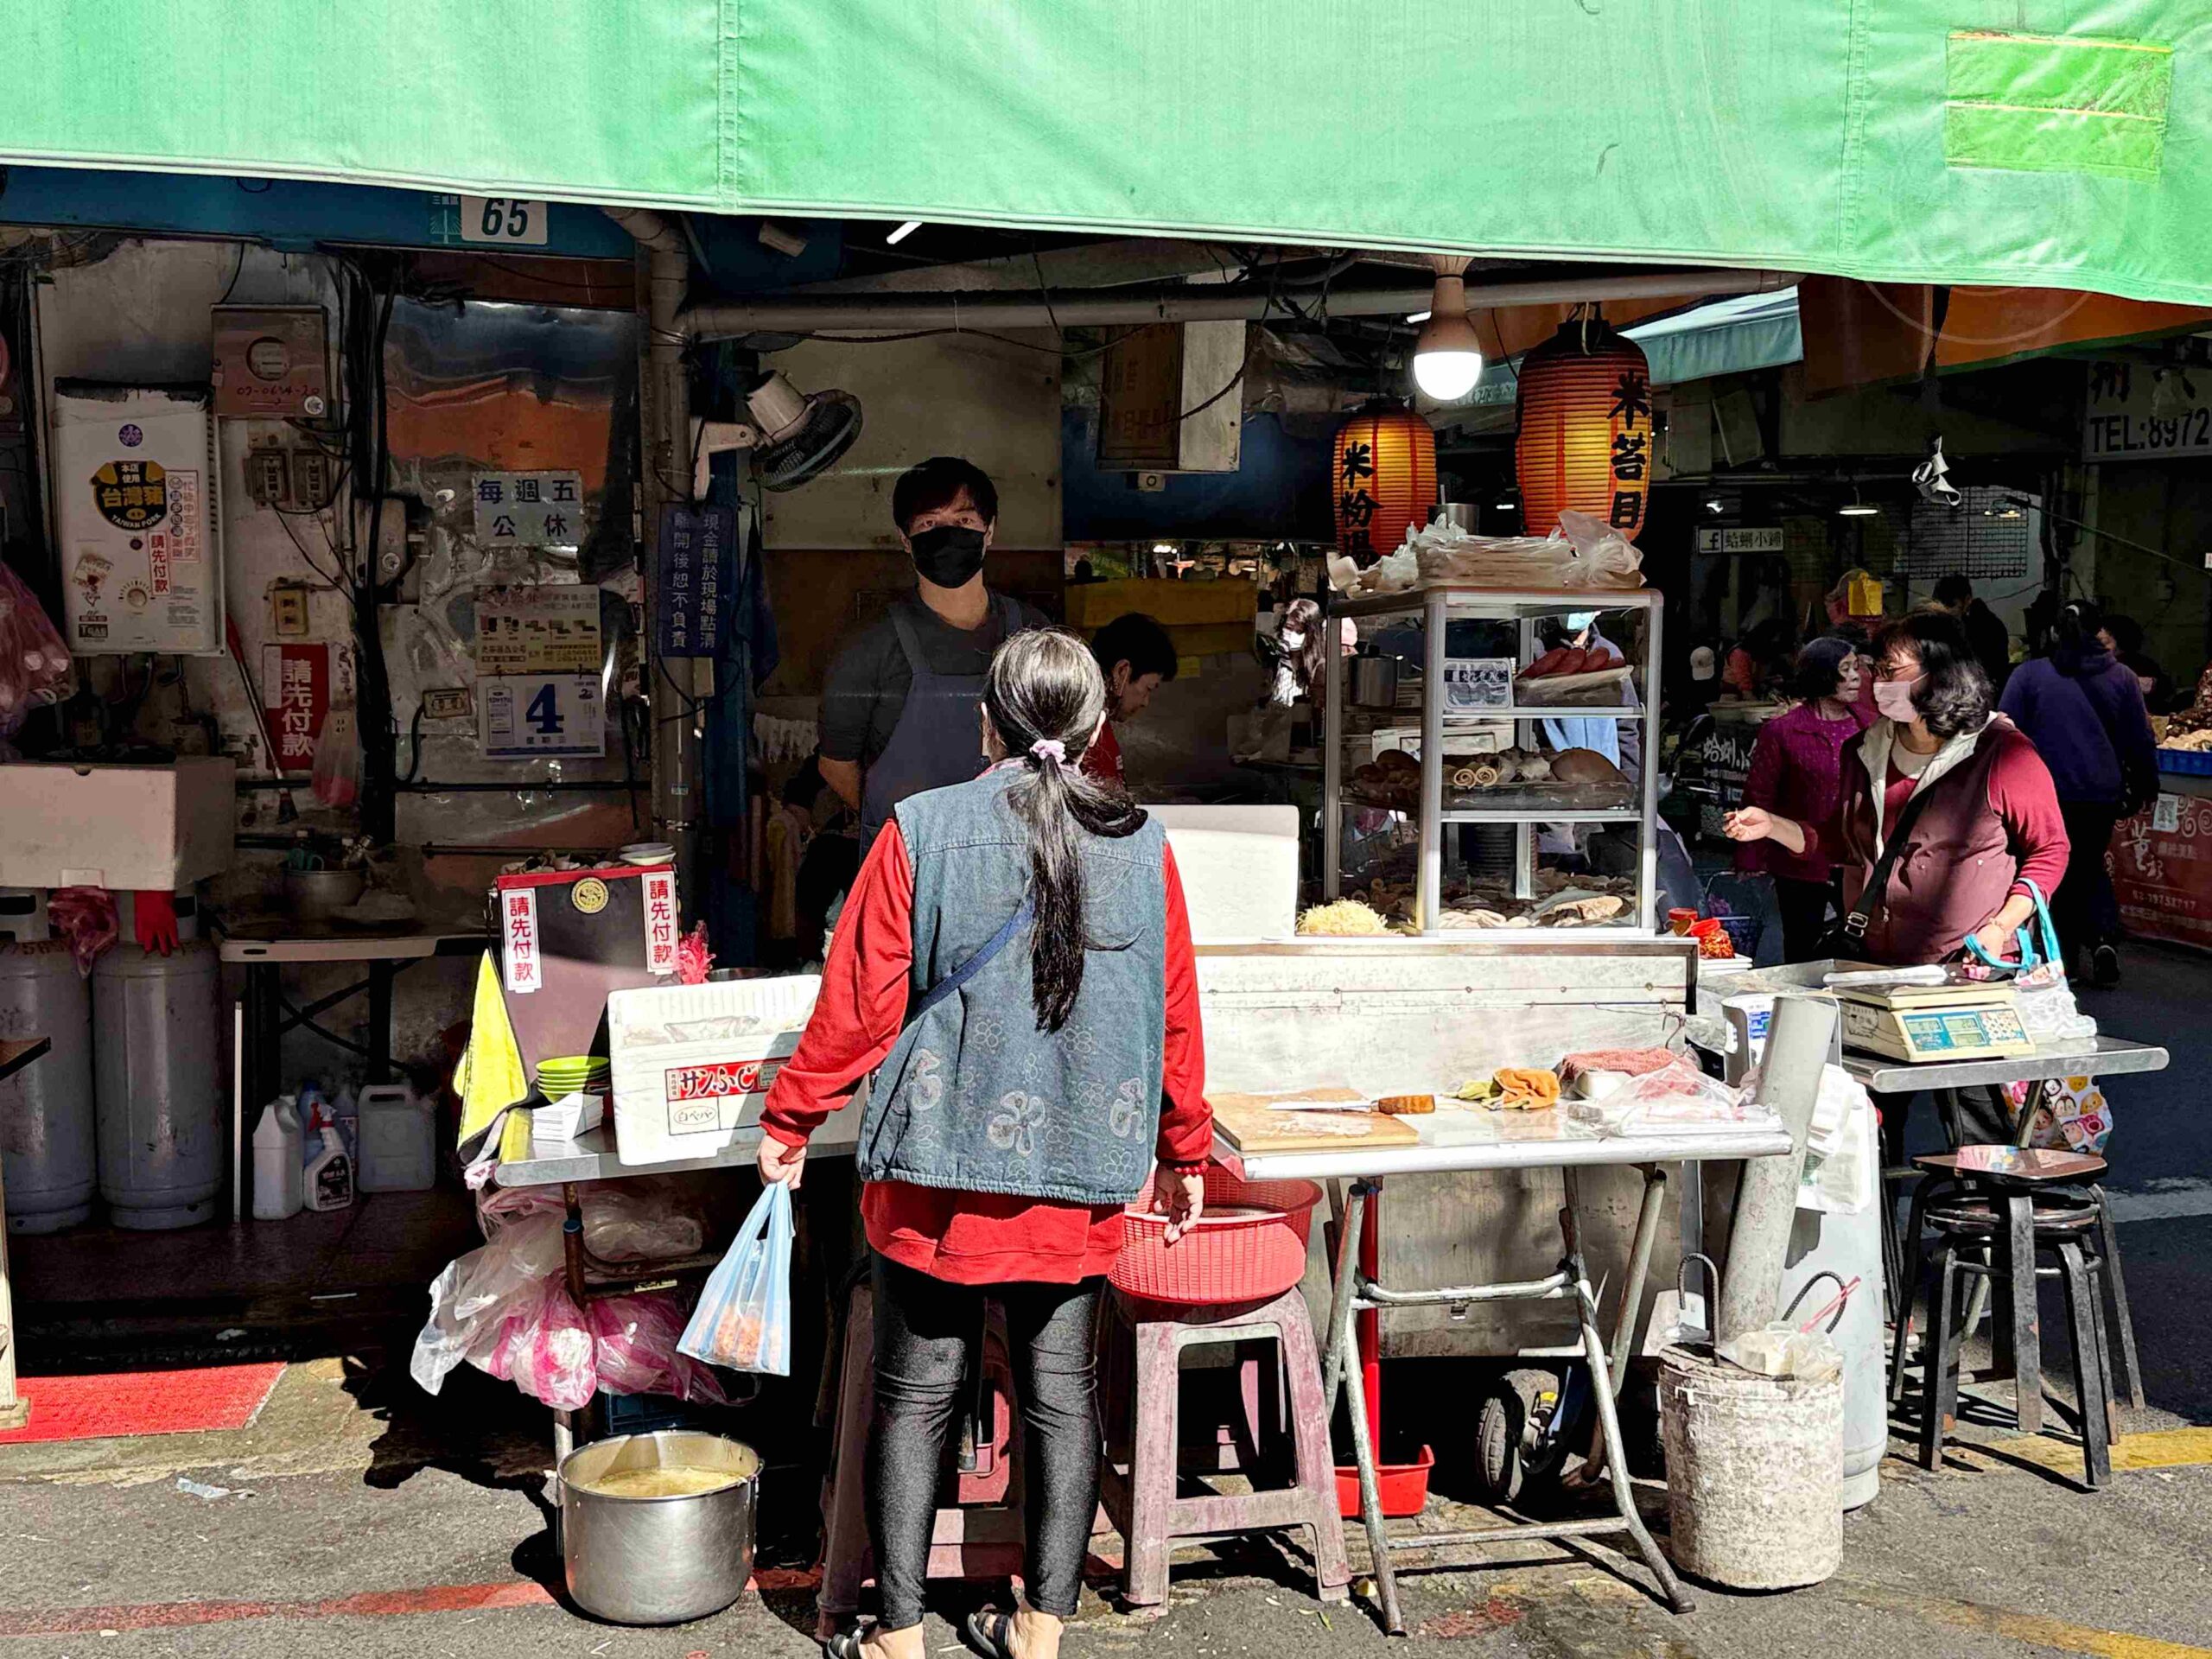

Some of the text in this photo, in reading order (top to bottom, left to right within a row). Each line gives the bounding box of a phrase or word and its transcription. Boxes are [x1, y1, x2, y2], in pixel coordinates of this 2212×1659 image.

[481, 197, 529, 237] 65
[1606, 368, 1649, 529] 米苔目
[101, 484, 165, 508] 台灣豬
[478, 479, 577, 504] 每週五
[111, 512, 162, 529] TAIWAN PORK
[493, 513, 567, 537] 公休
[150, 535, 168, 593] 請先付款
[671, 512, 690, 648] 離開後恕不負責
[699, 513, 719, 649] 現金請於現場點清
[282, 658, 314, 757] 請先付款
[525, 683, 564, 734] 4
[509, 896, 534, 982] 請先付款
[650, 879, 673, 964] 請先付款
[680, 1065, 757, 1096] サンふじ
